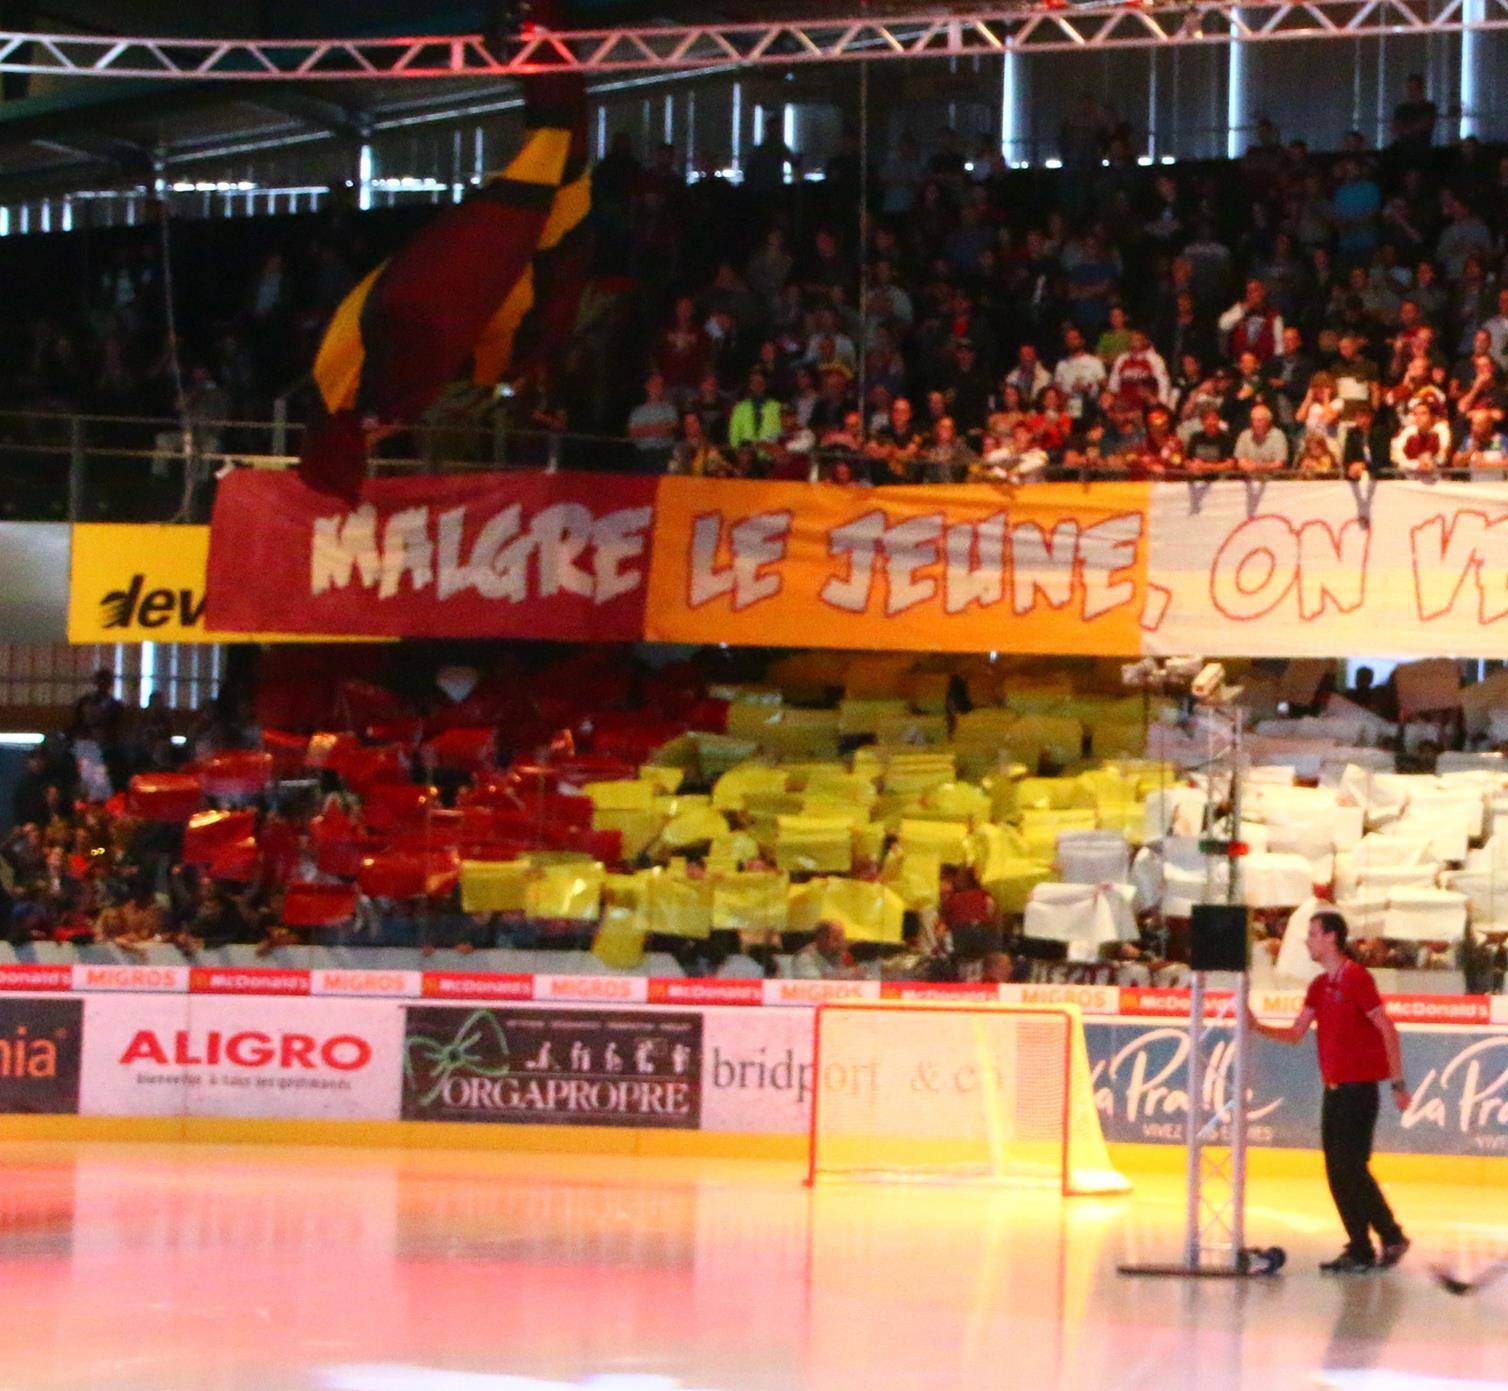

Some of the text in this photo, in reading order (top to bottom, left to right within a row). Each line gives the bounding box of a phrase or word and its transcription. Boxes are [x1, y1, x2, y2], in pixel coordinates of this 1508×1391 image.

[311, 503, 652, 602] MALGRE
[689, 509, 794, 613] LE
[820, 508, 1172, 631] JEUNE,
[1210, 513, 1371, 621] ON
[86, 970, 176, 987] MIGROS
[211, 973, 309, 991] McDonald's
[323, 974, 406, 992] MIGROS
[1385, 1001, 1487, 1017] McDonald's
[119, 1029, 373, 1071] ALIGRO
[442, 1075, 691, 1114] ORGAPROPRE
[713, 1046, 881, 1104] bridport
[910, 1060, 937, 1093] &
[1401, 1069, 1446, 1129] La
